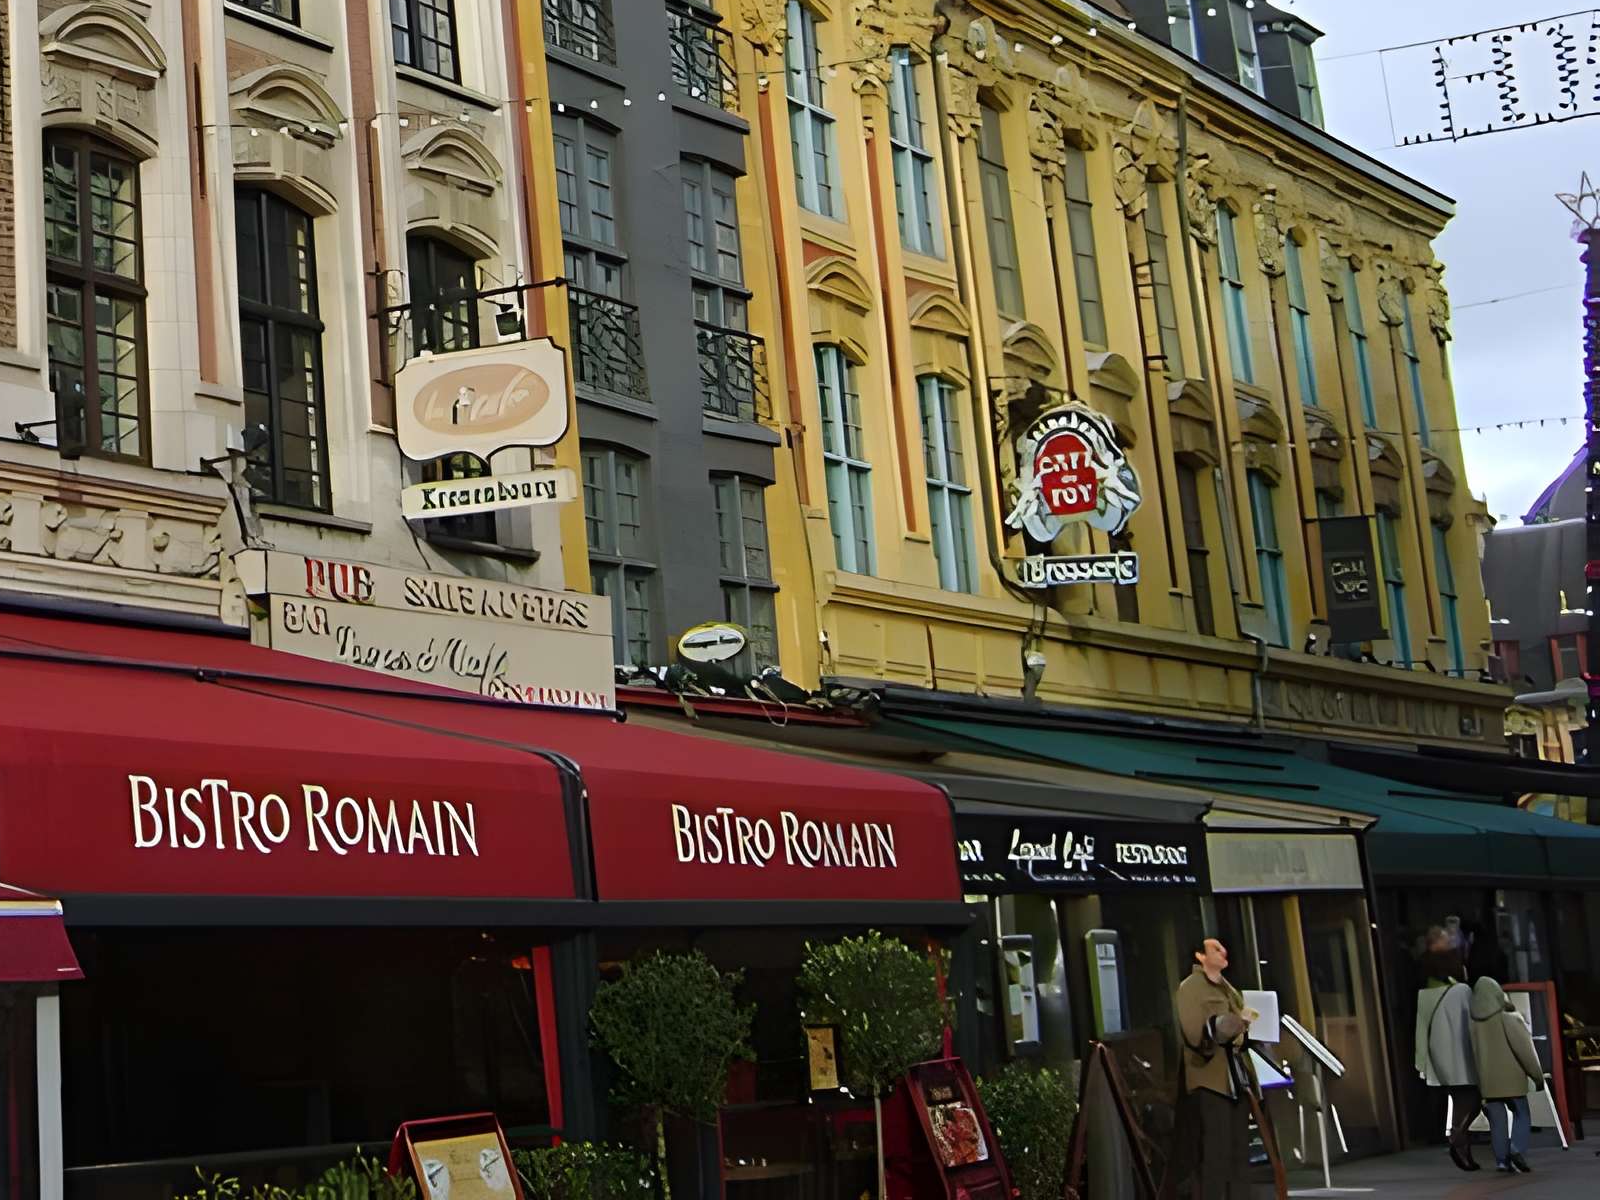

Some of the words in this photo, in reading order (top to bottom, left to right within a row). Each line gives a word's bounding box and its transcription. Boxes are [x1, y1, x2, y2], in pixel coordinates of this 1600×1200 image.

[304, 557, 375, 604] PUB
[128, 774, 291, 855] BISTRO
[301, 783, 480, 857] ROMAIN
[671, 803, 776, 868] BISTRO
[780, 811, 898, 868] ROMAIN
